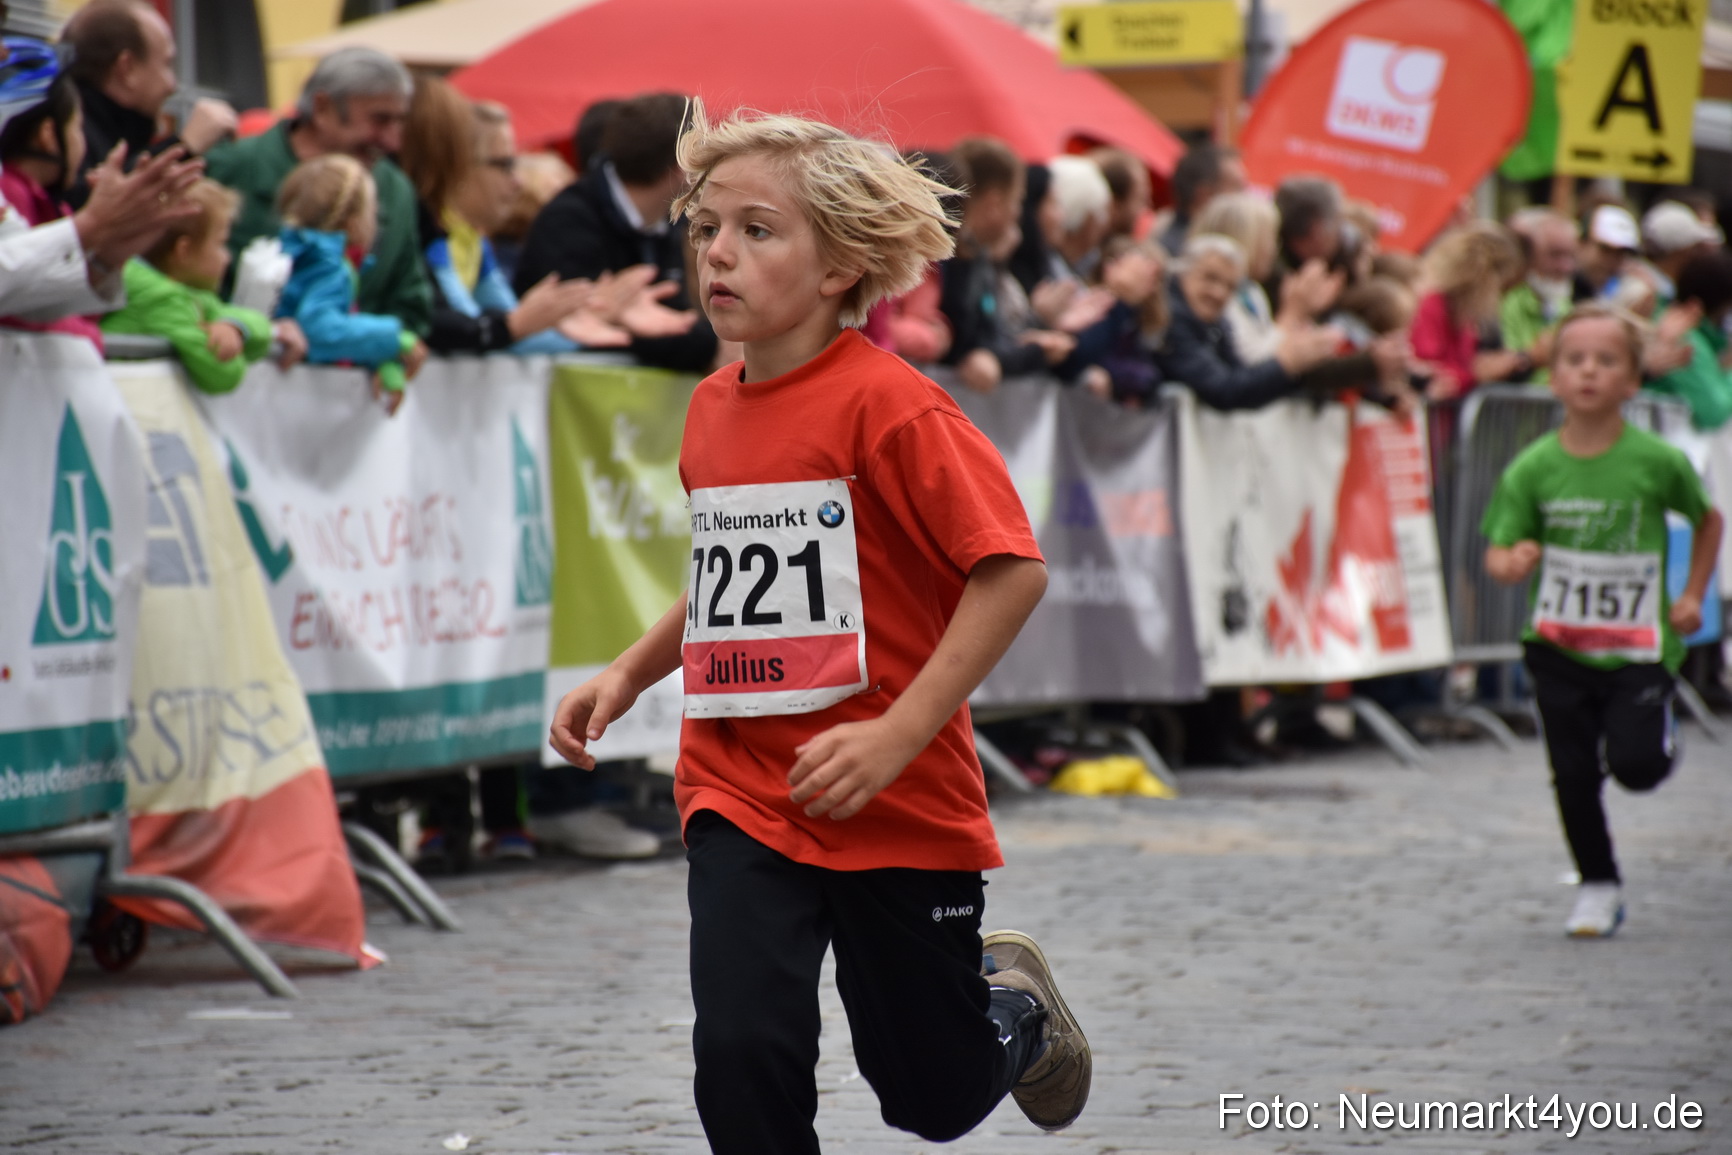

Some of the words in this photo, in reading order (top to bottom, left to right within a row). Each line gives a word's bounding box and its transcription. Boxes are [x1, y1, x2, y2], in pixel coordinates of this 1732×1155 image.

[1594, 42, 1665, 135] A
[714, 508, 807, 531] Neumarkt
[692, 540, 826, 629] 7221
[1554, 575, 1647, 620] 7157
[840, 614, 849, 629] K
[705, 652, 785, 685] Julius
[943, 905, 974, 917] JAKO
